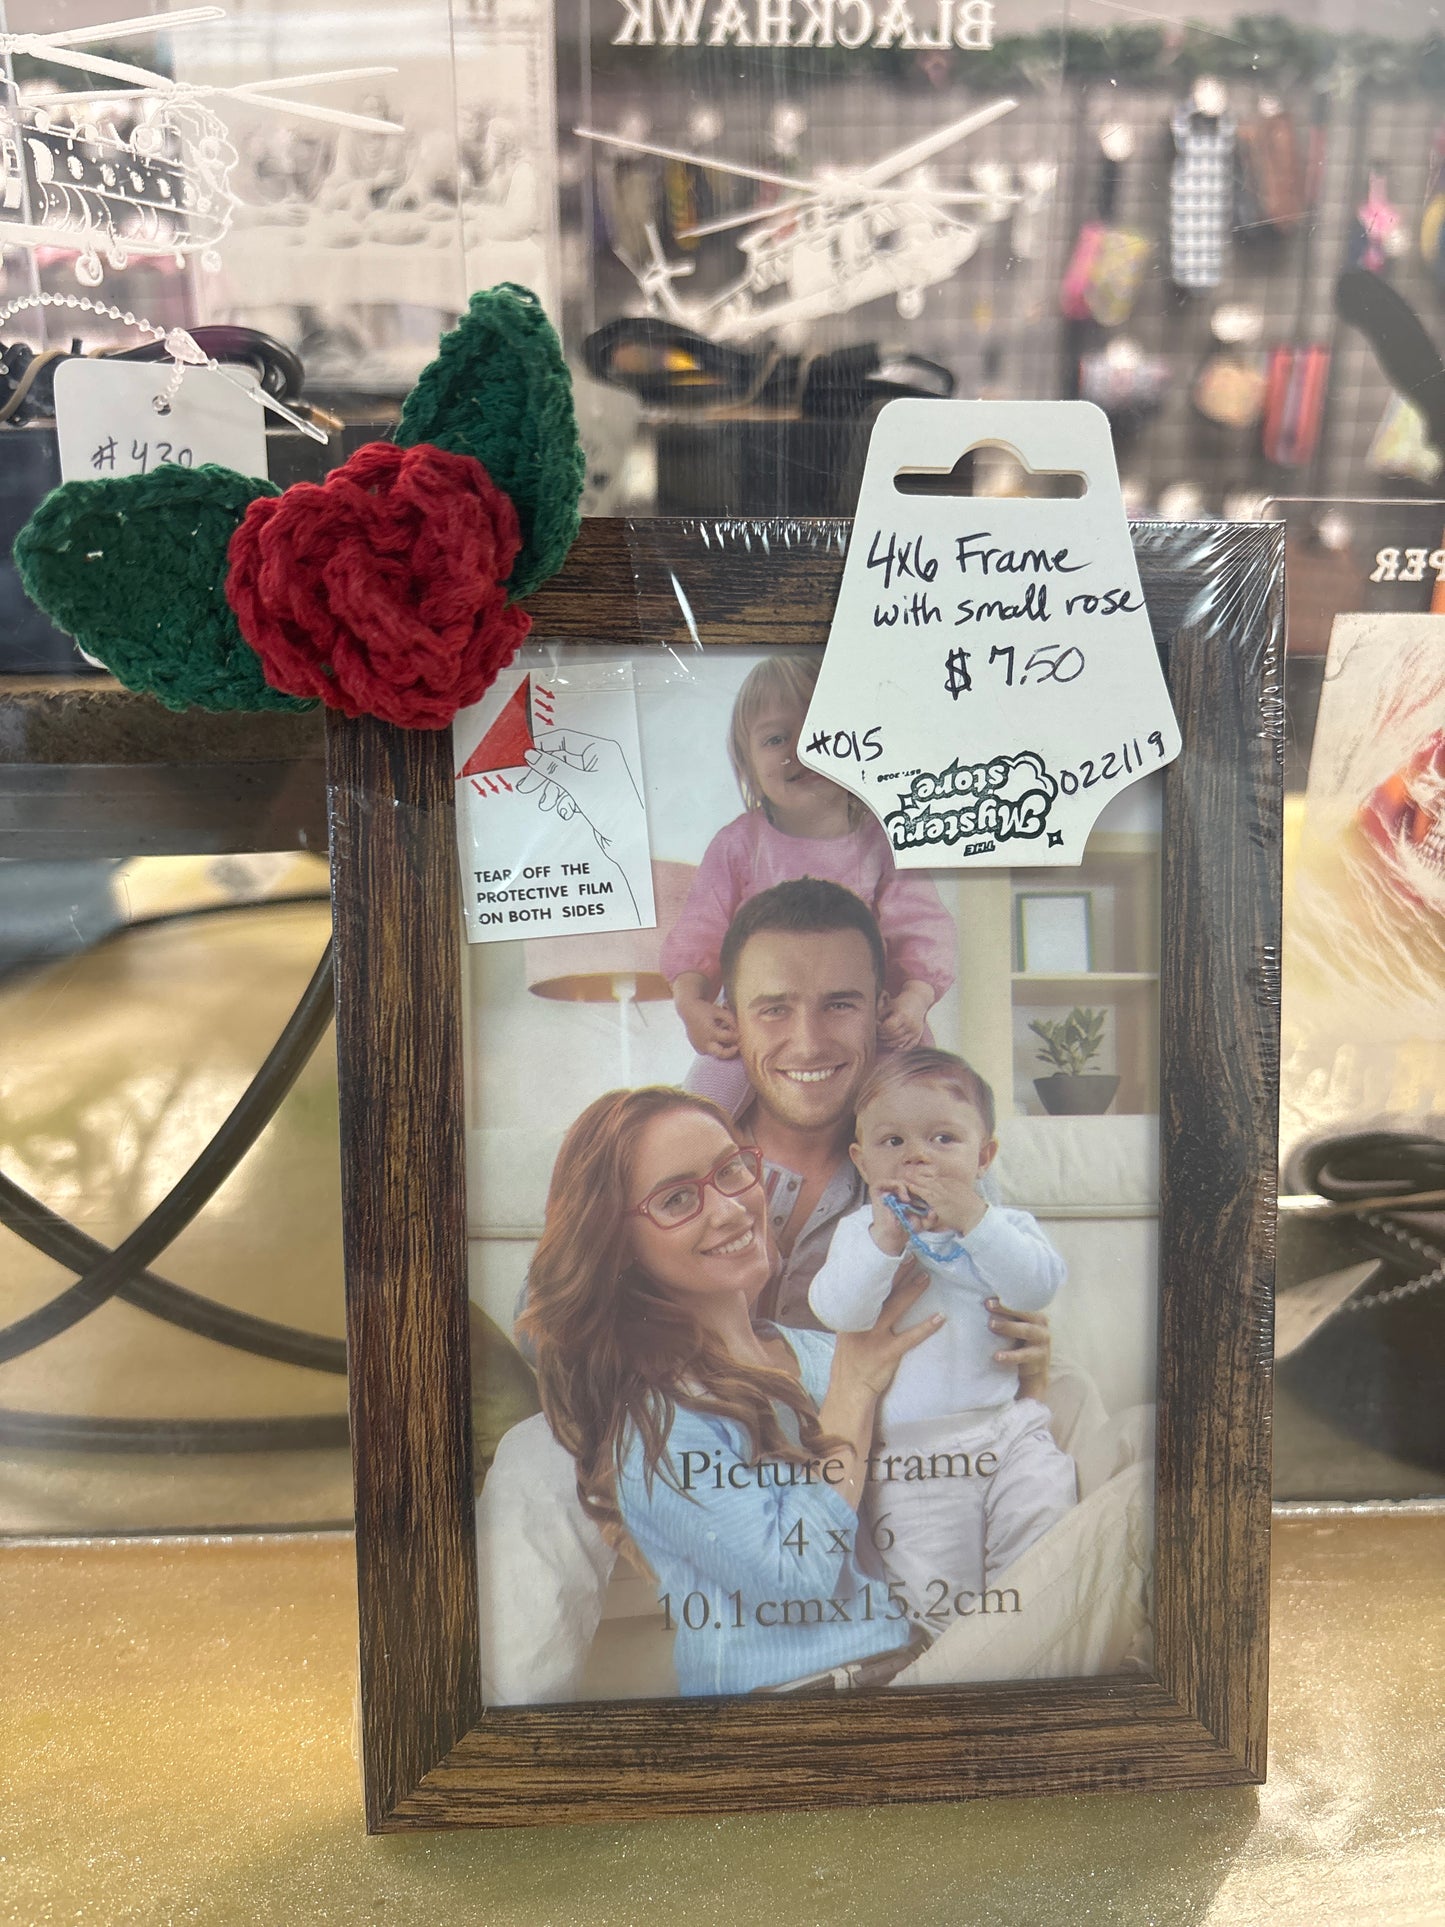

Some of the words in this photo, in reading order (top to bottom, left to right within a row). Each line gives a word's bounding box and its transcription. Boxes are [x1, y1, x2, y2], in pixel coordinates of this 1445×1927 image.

[955, 531, 1093, 575] Frame
[873, 591, 942, 627] with
[954, 582, 1052, 626] small
[1065, 588, 1146, 616] rose
[806, 726, 883, 762] #015
[885, 791, 1048, 850] Mystery
[963, 840, 996, 856] THE
[474, 869, 513, 884] TEAR
[522, 866, 551, 880] OFF
[561, 862, 590, 877] THE
[476, 885, 569, 904] PROTECTIVE
[578, 881, 614, 896] FILM
[479, 912, 503, 926] ON
[508, 907, 552, 924] BOTH
[562, 903, 605, 919] SIDES
[677, 1449, 845, 1490] Picture
[864, 1449, 998, 1483] frame
[782, 1517, 810, 1557] 4
[870, 1512, 895, 1552] 6
[657, 1578, 1023, 1632] 10.1cmx15.2cm
